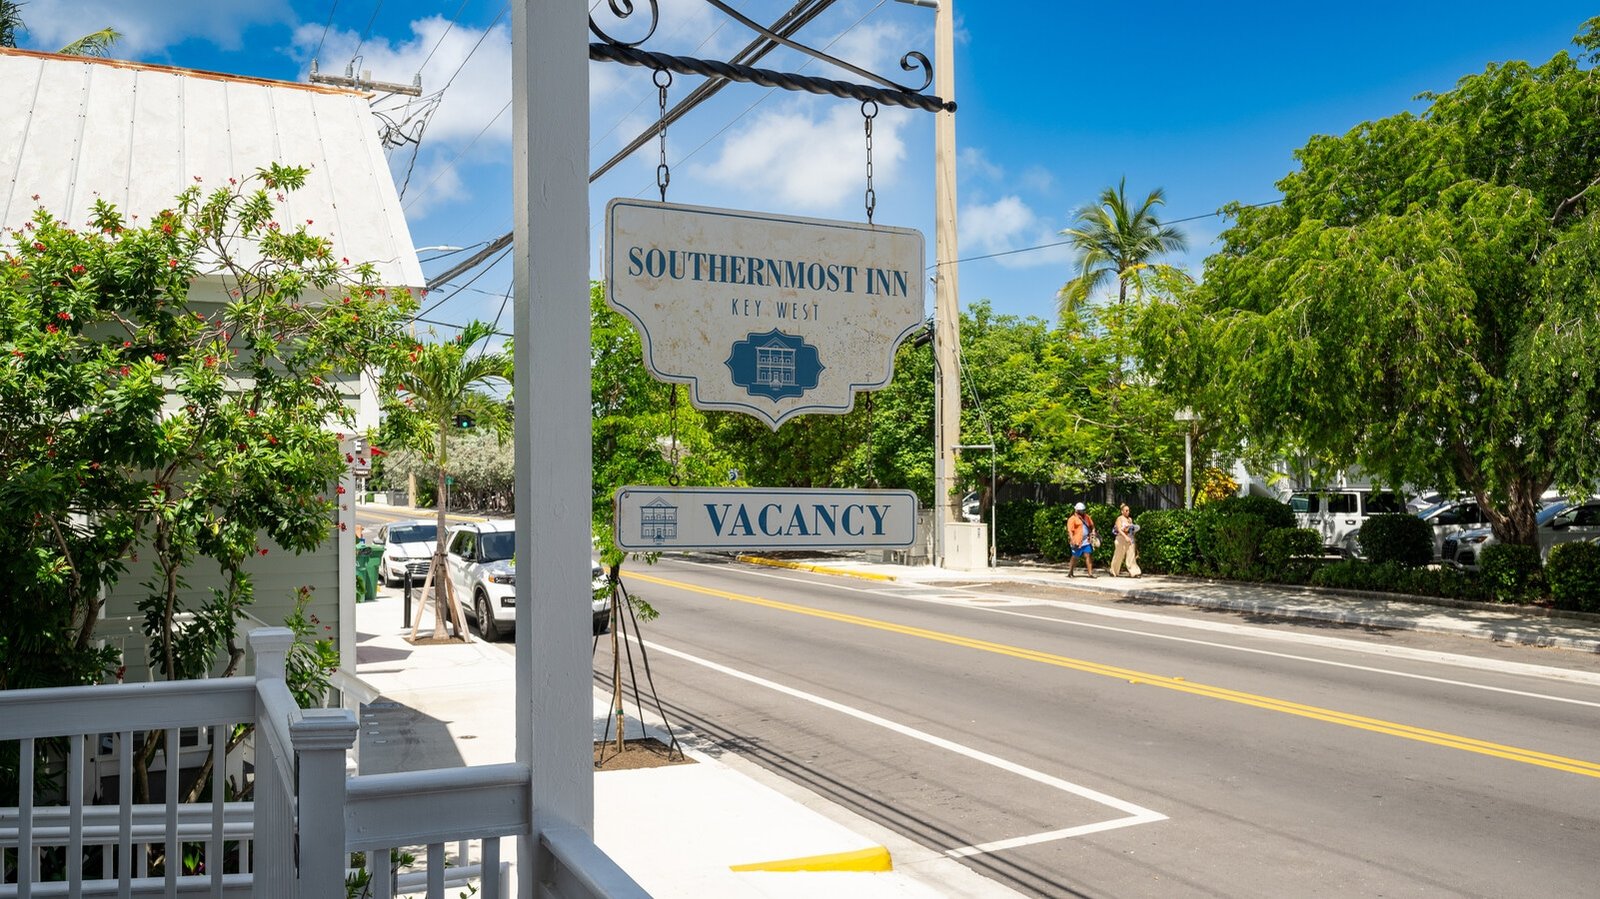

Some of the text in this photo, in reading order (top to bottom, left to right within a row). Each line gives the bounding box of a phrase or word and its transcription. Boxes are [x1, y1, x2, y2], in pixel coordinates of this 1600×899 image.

[628, 246, 909, 298] SOUTHERNMOST INN
[732, 298, 820, 321] KEY WEST
[704, 503, 892, 536] VACANCY
